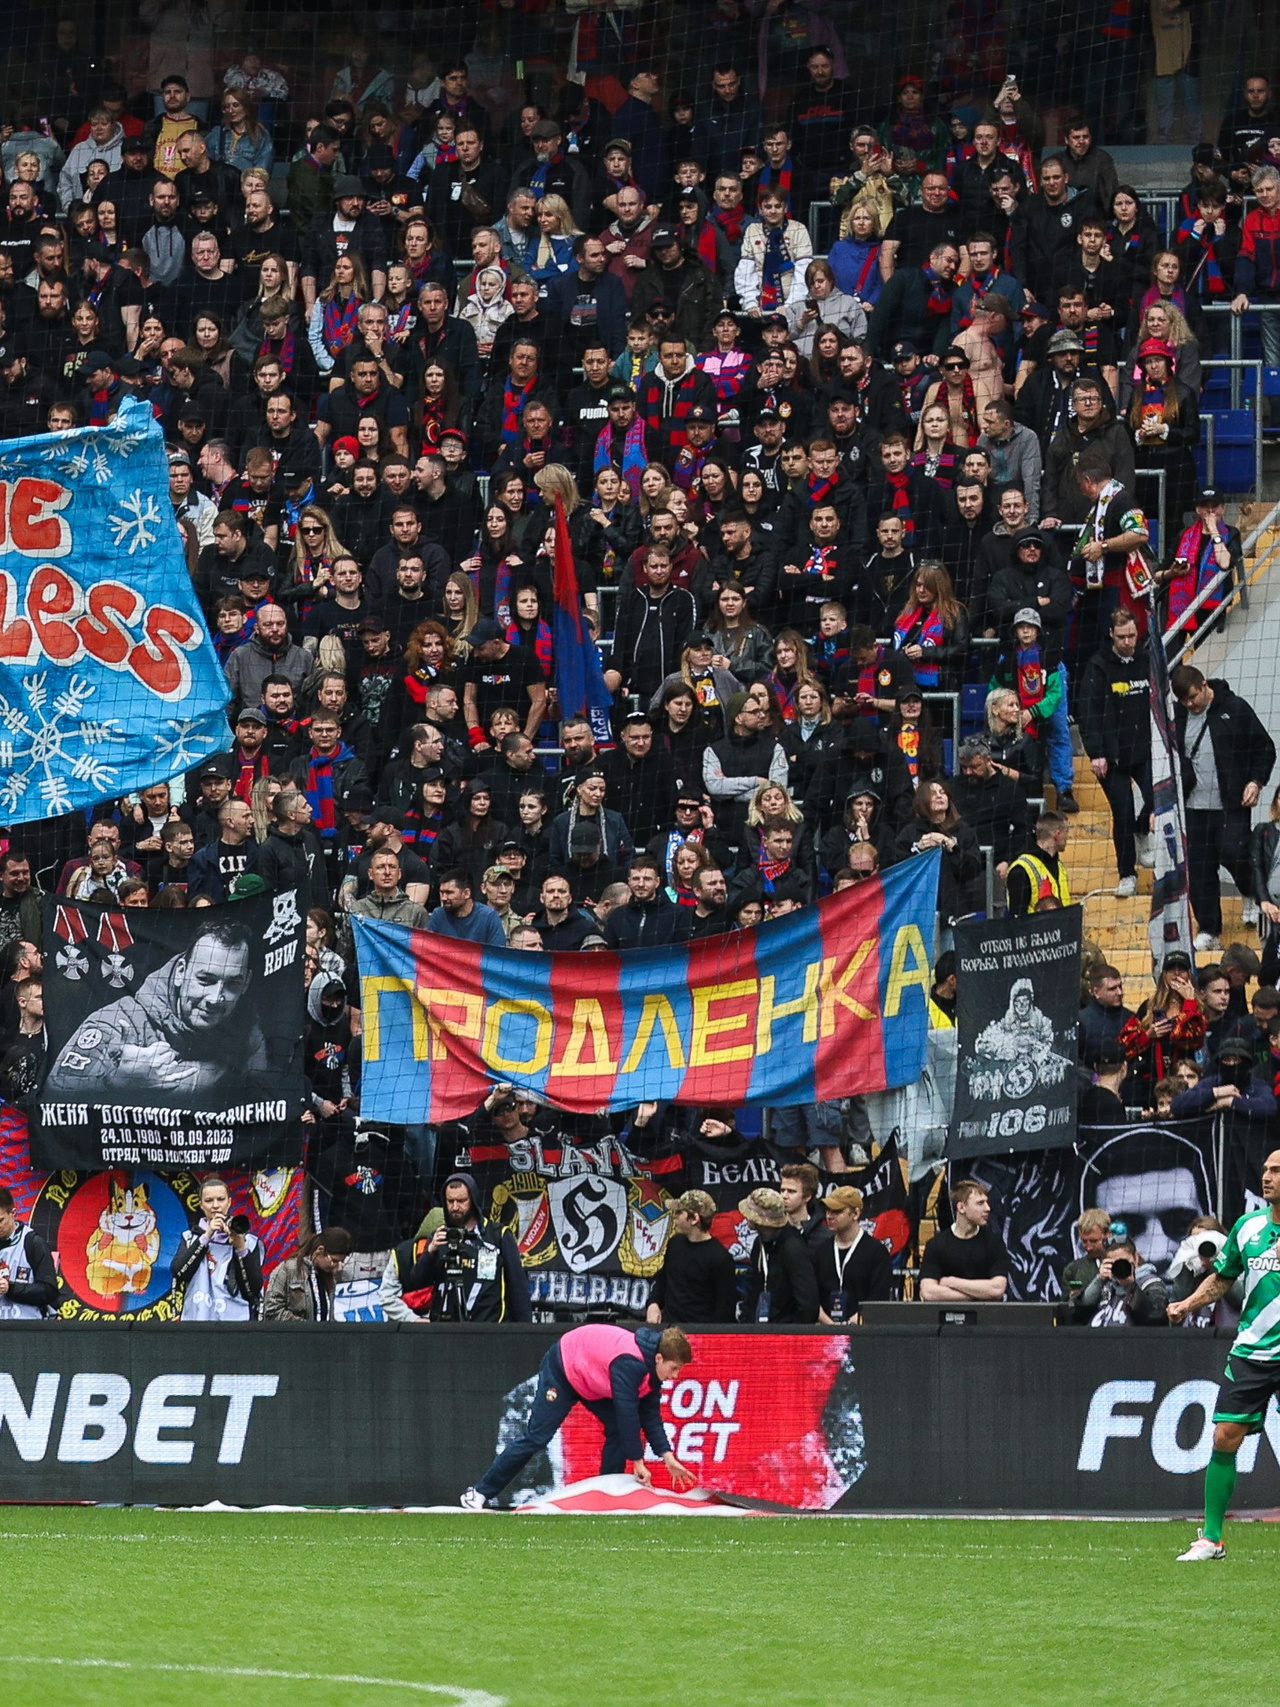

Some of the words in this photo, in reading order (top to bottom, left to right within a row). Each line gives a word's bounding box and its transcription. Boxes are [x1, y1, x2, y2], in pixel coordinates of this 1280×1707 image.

[580, 407, 609, 419] PUMA
[263, 940, 298, 978] RBW
[960, 957, 999, 972] БОРЬБА
[361, 924, 931, 1077] ПРОДЛЕНКА
[40, 1103, 89, 1127] ЖЕНЯ
[93, 1104, 191, 1127] "БОГОМОЛ"
[986, 1104, 1047, 1138] 106
[102, 1147, 141, 1164] ОТРЯД
[211, 1148, 232, 1163] ВДВ
[512, 1172, 538, 1190] 1910
[523, 1210, 547, 1247] WIDZEW
[635, 1219, 658, 1252] ЦСКА
[527, 1270, 653, 1310] THERHO
